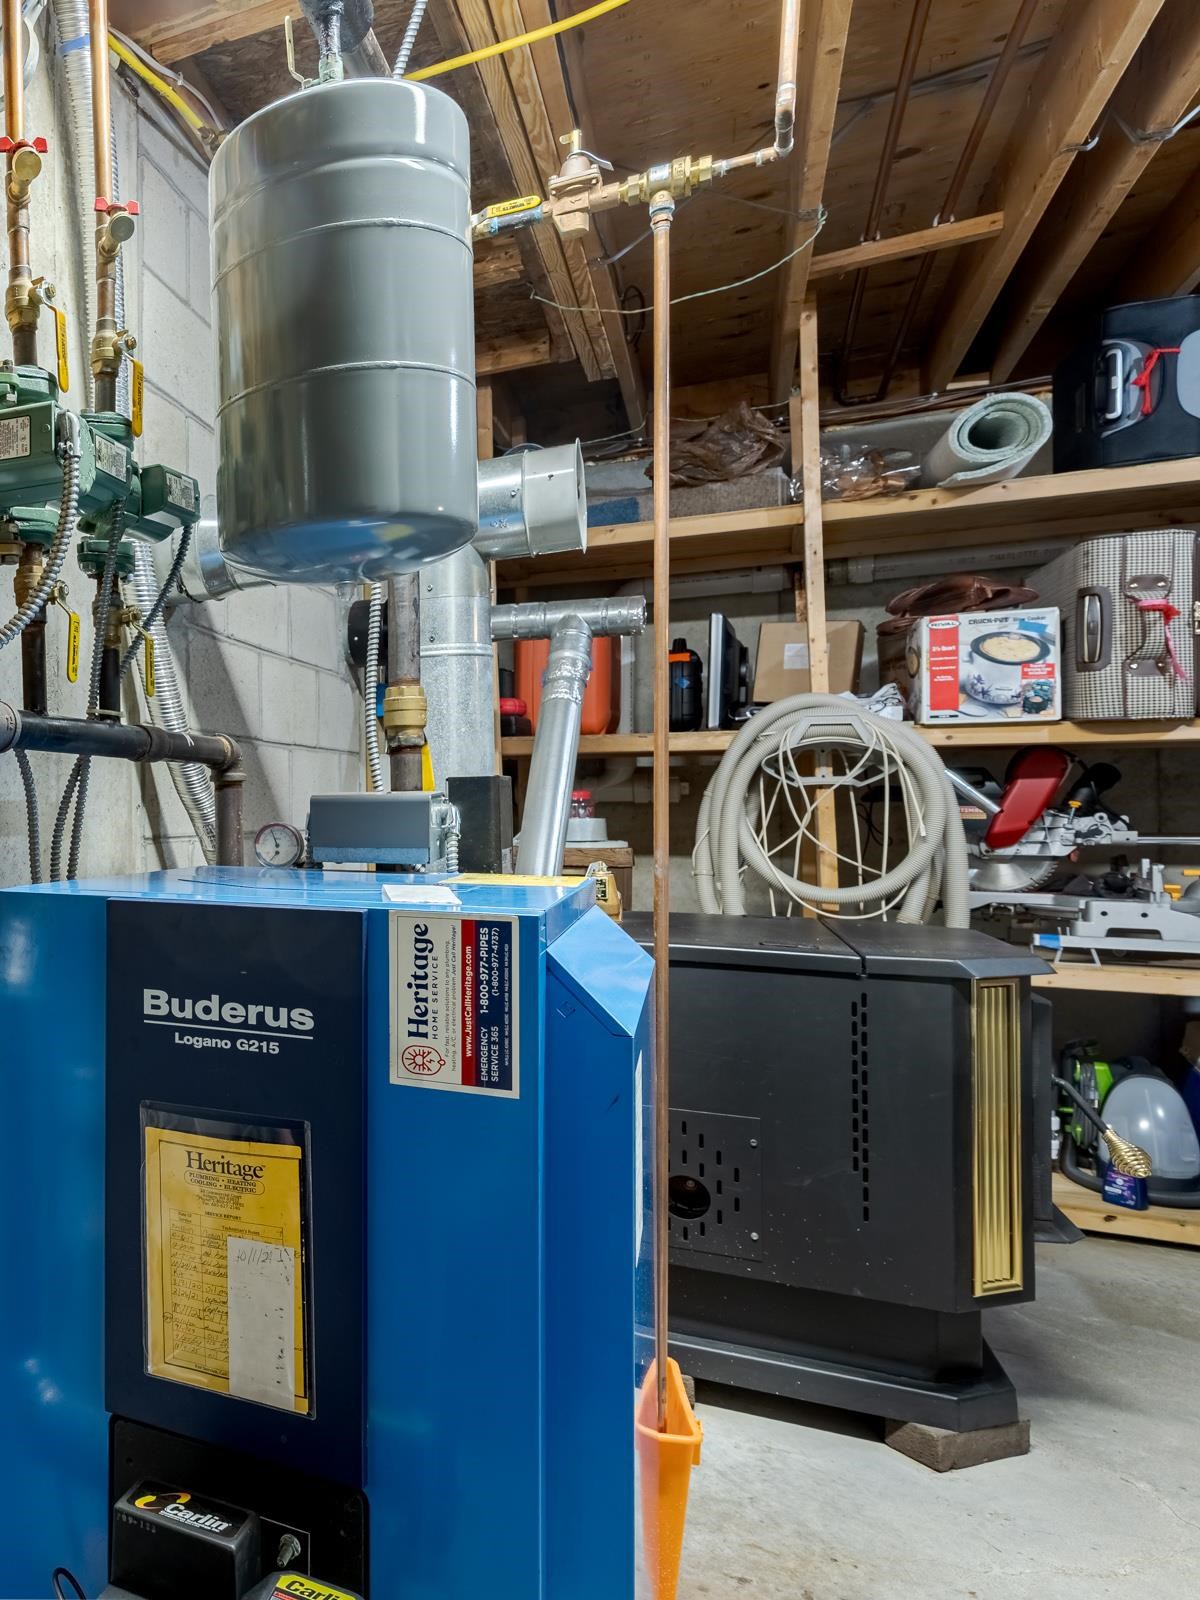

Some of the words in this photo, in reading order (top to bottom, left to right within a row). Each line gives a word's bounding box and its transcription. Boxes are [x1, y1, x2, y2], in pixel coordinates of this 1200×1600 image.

[480, 927, 489, 1014] 1-800-977-PIPES
[491, 927, 500, 997] (1-800-977-4737)
[406, 923, 435, 1040] Heritage
[143, 988, 315, 1031] Buderus
[465, 945, 473, 1058] www.JustCallHeritage.com
[174, 1032, 231, 1049] Logano
[236, 1039, 280, 1055] G215
[490, 1026, 499, 1043] 365
[480, 1027, 489, 1082] EMERGENCY
[490, 1043, 499, 1083] SERVICE
[186, 1151, 264, 1181] Heritage
[188, 1172, 220, 1183] PLUMBING
[227, 1179, 257, 1188] HEATING
[190, 1178, 218, 1188] COOLING
[224, 1184, 257, 1194] ELECTRIC
[166, 1503, 230, 1531] Carlin
[285, 1579, 343, 1600] Carli
